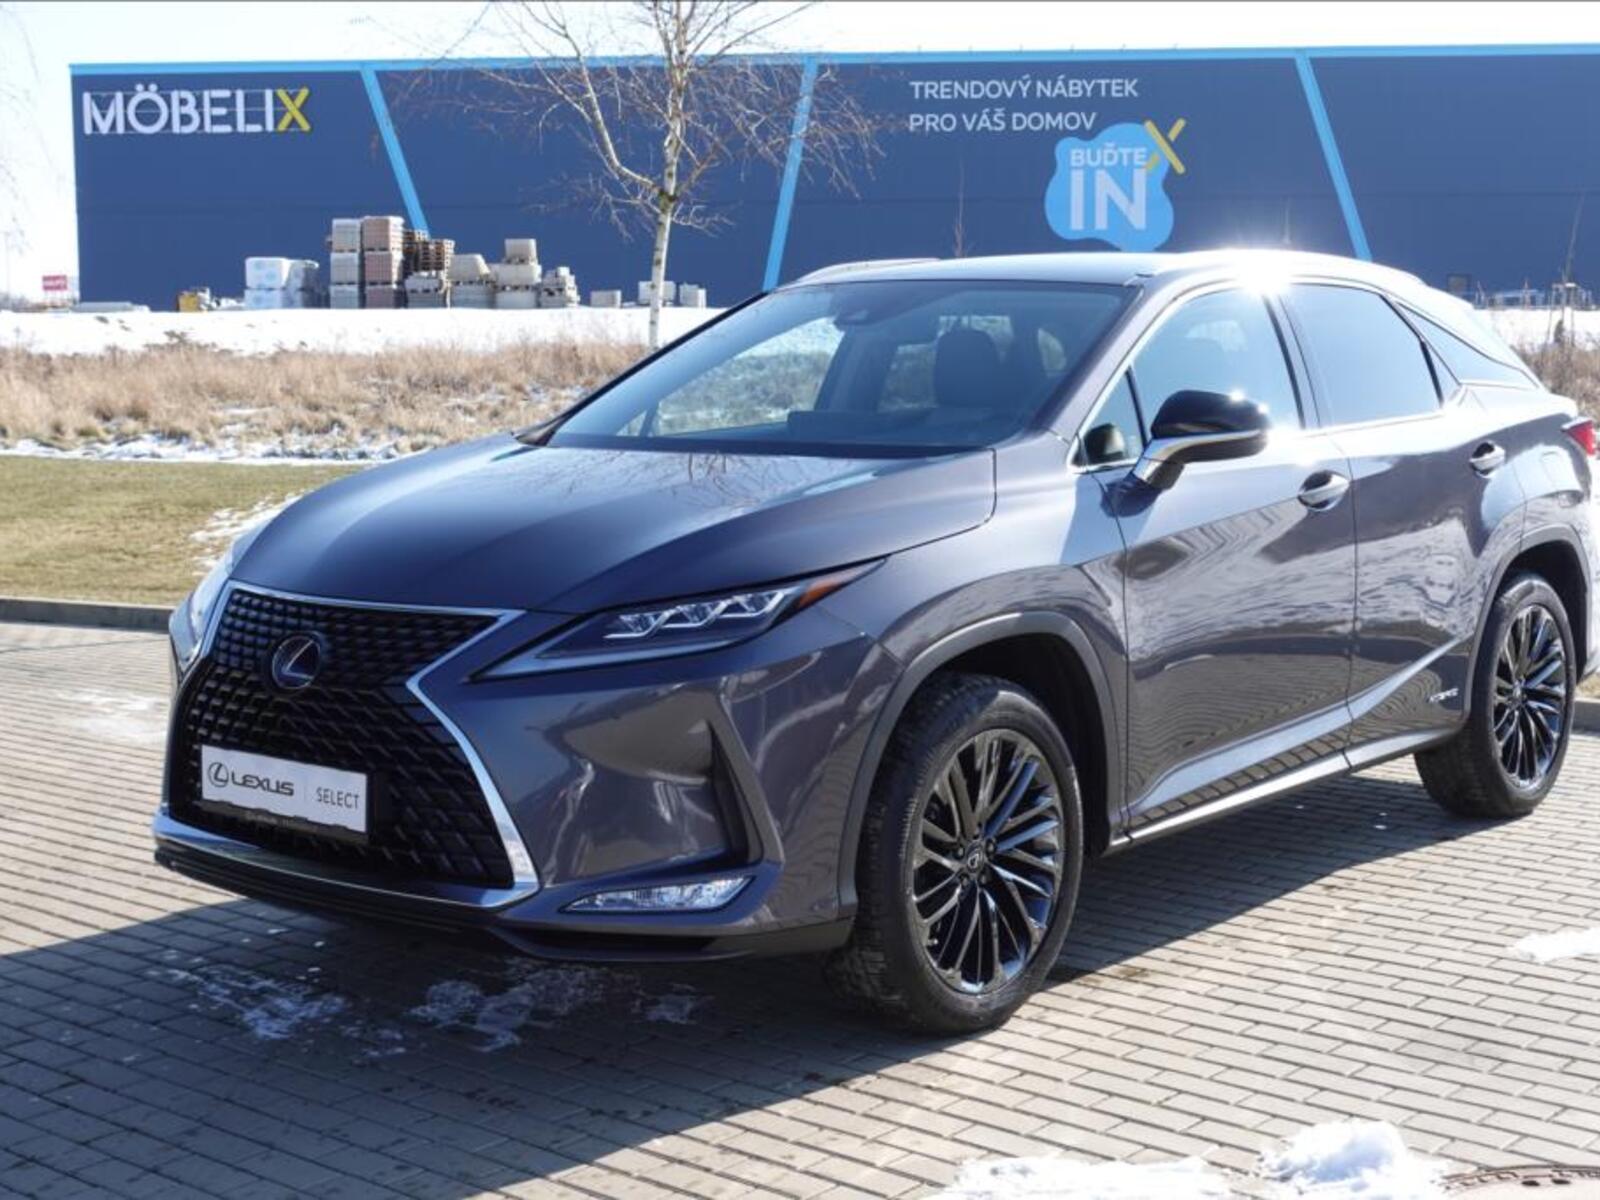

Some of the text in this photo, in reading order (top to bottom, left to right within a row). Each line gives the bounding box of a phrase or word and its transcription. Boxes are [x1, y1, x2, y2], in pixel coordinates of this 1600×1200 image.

[909, 74, 1139, 99] TRENDOVÝ NÁBYTEK
[83, 84, 311, 134] MÖBELIX
[909, 108, 1097, 132] PRO VÁŠ DOMOV
[1070, 143, 1147, 167] BUĎTE
[1070, 168, 1147, 231] IN
[231, 771, 360, 809] LEXUS SELECT
